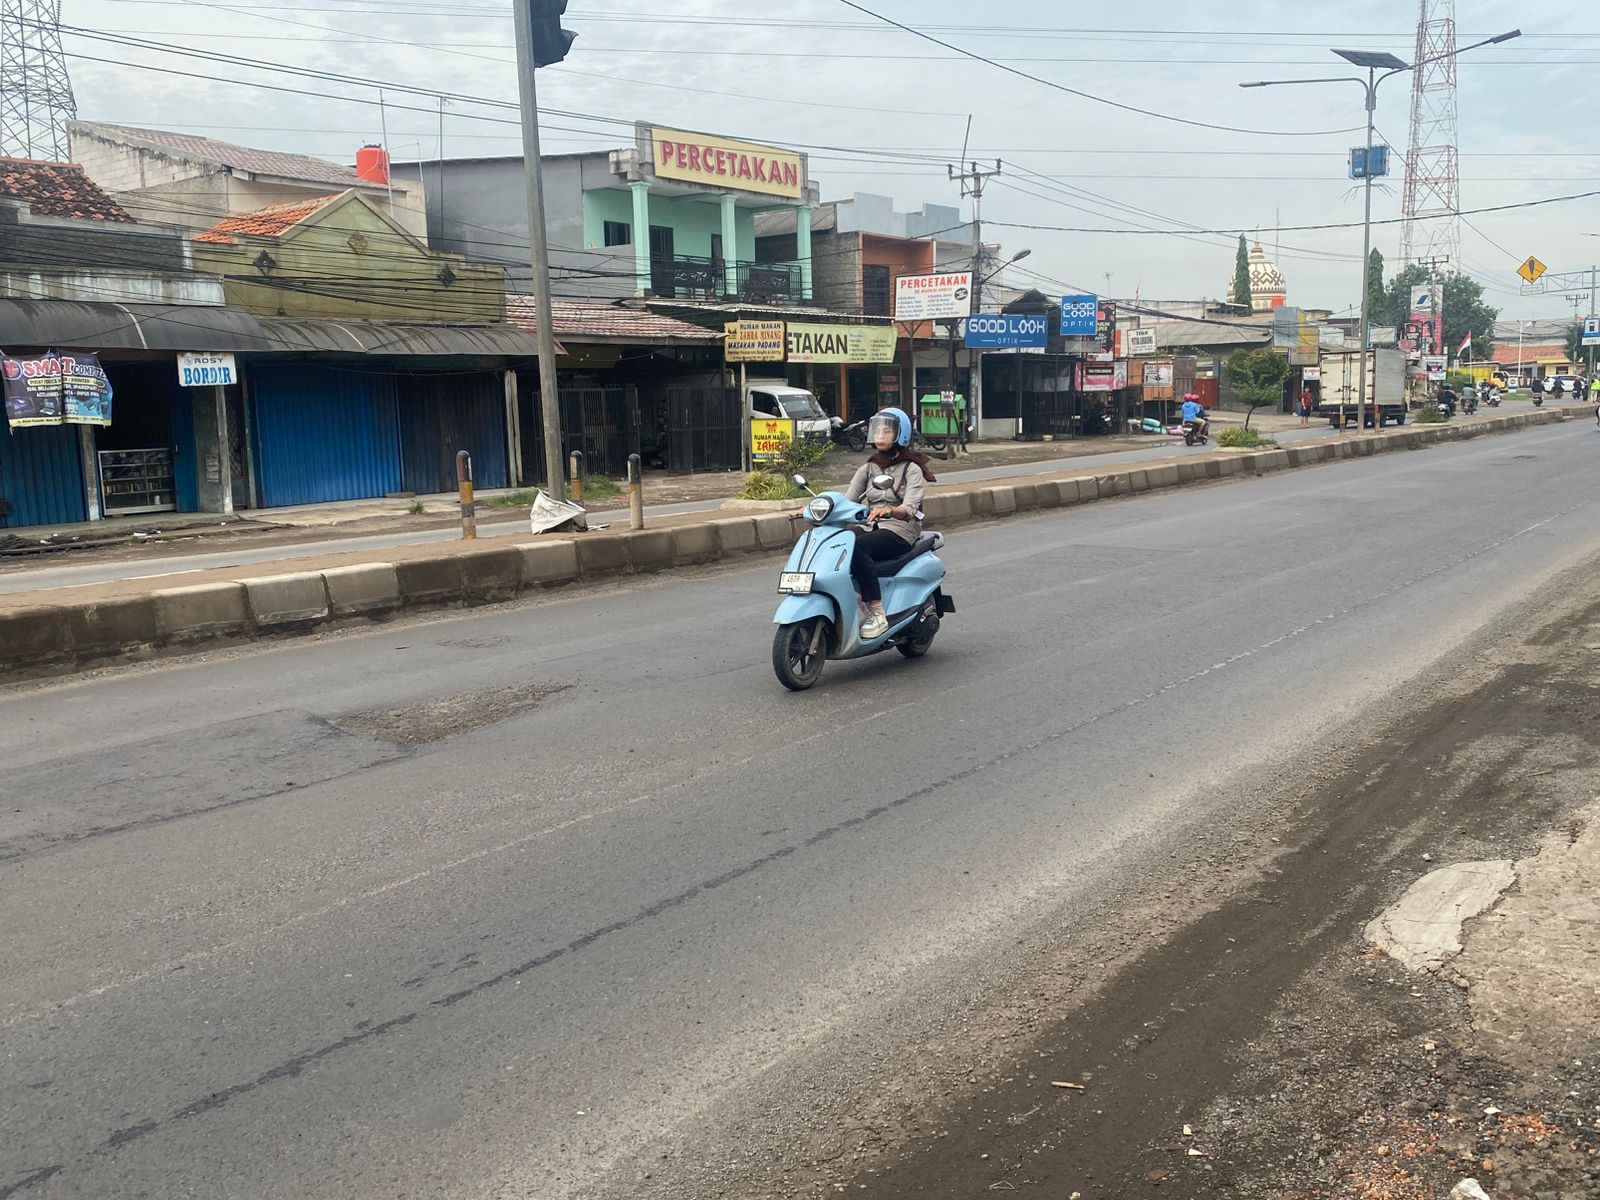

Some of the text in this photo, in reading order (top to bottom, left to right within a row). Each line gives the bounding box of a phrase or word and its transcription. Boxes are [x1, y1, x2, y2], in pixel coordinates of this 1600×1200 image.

[660, 139, 798, 186] PERCETAKAN
[900, 275, 967, 289] PERCETAKAN
[1063, 302, 1095, 310] GOOD
[761, 322, 781, 330] MAKAN
[968, 318, 1007, 333] GOOD
[1062, 320, 1095, 328] OPTIK
[727, 341, 781, 349] MASAKAN PADANG
[997, 337, 1019, 345] OPTIK
[183, 367, 232, 385] BORDIR
